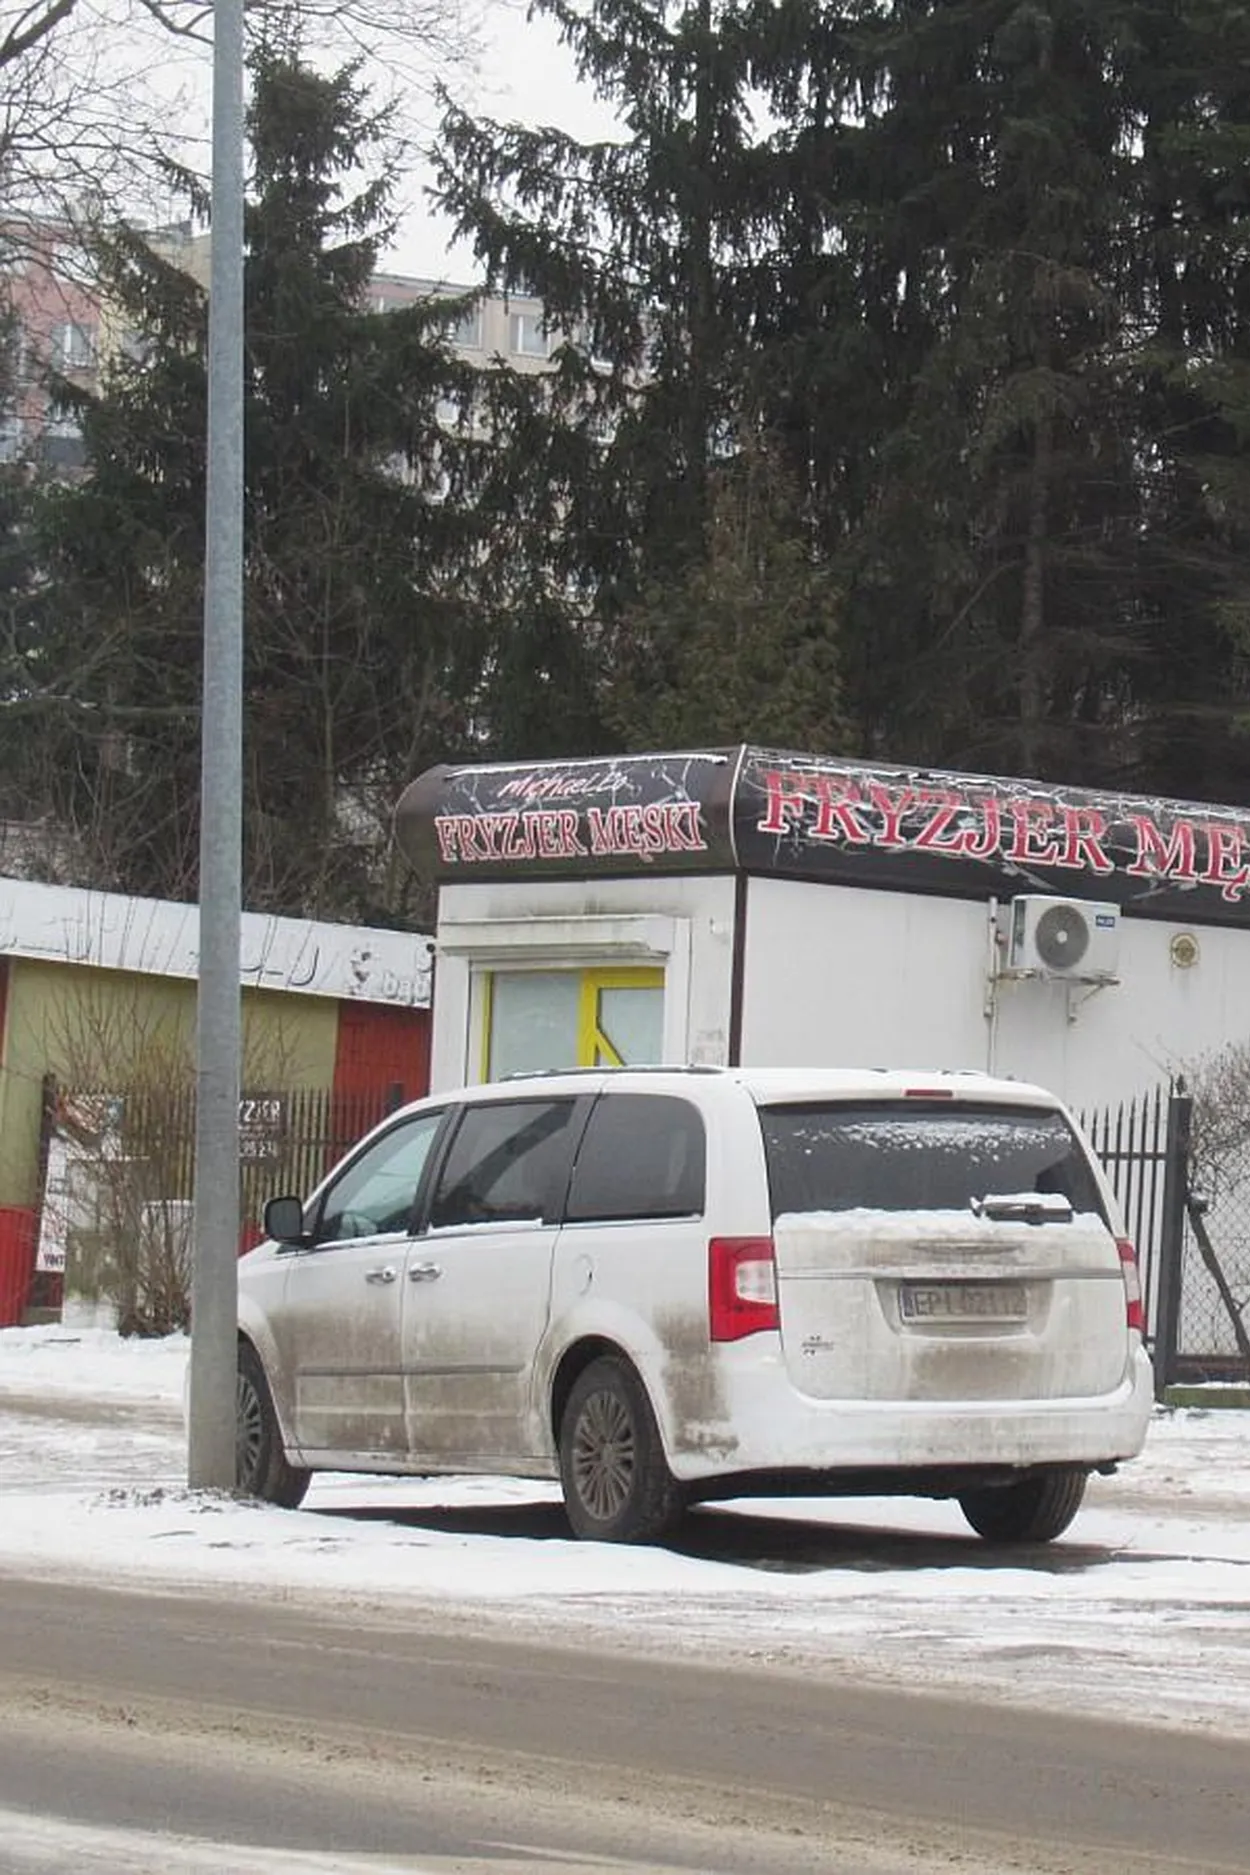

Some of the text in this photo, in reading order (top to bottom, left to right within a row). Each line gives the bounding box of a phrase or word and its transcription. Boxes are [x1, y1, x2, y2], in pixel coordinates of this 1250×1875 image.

[435, 802, 707, 862] FRYZJER MĘSKI
[757, 768, 1115, 874] FRYZJER
